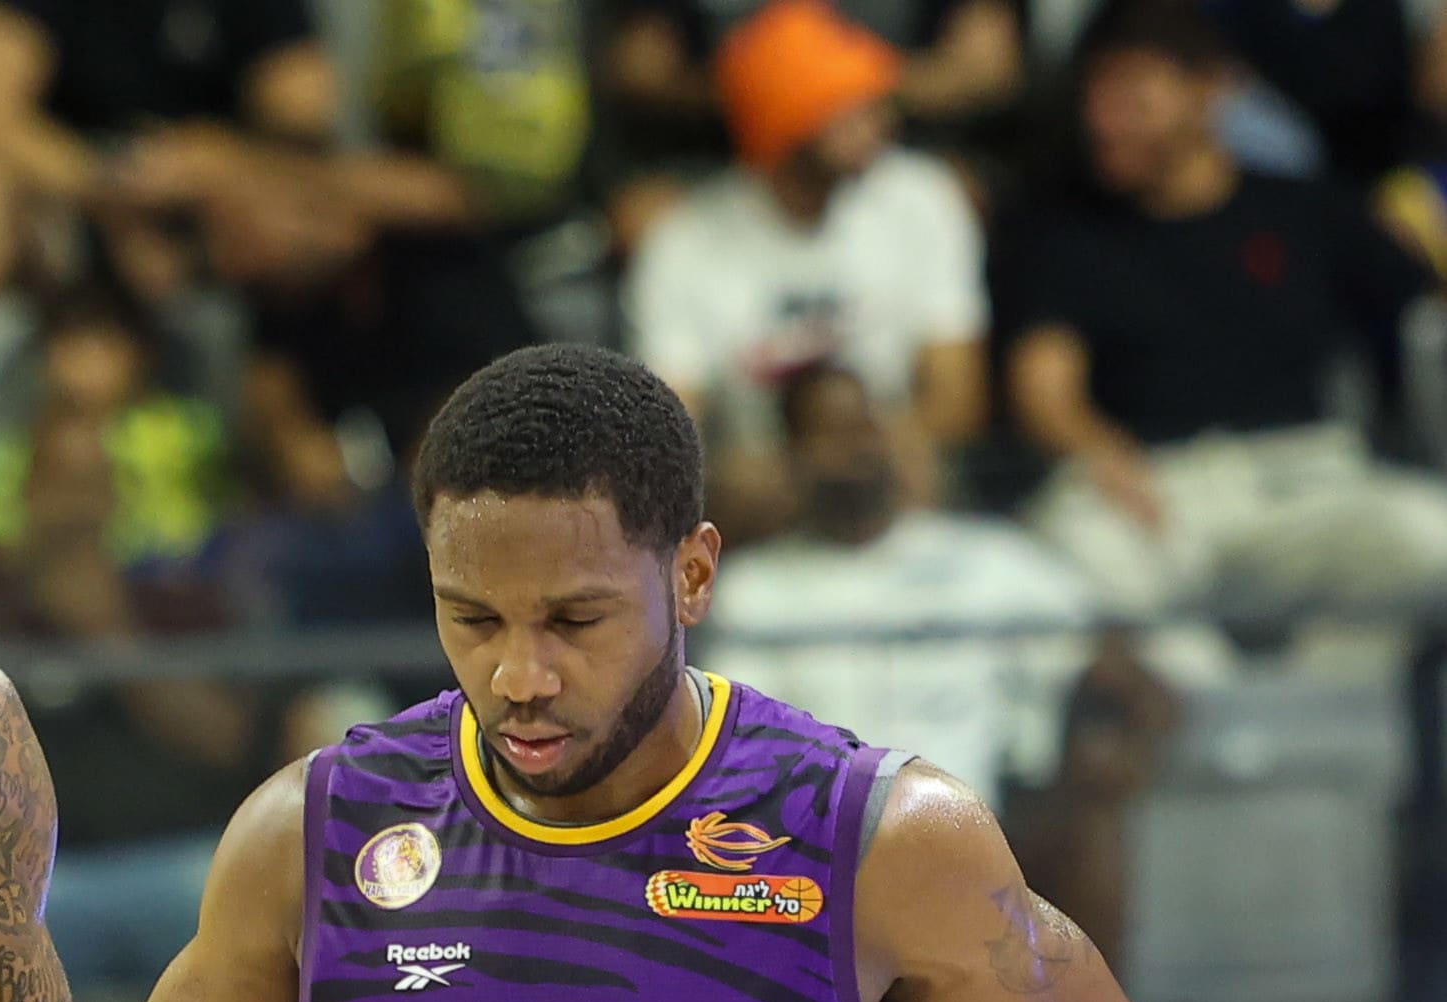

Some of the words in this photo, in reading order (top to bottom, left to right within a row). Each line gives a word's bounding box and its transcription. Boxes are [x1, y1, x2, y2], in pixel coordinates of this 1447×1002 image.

[666, 883, 772, 913] Winner
[774, 894, 800, 913] סל
[734, 880, 771, 898] ליגת
[387, 942, 471, 965] Reebok
